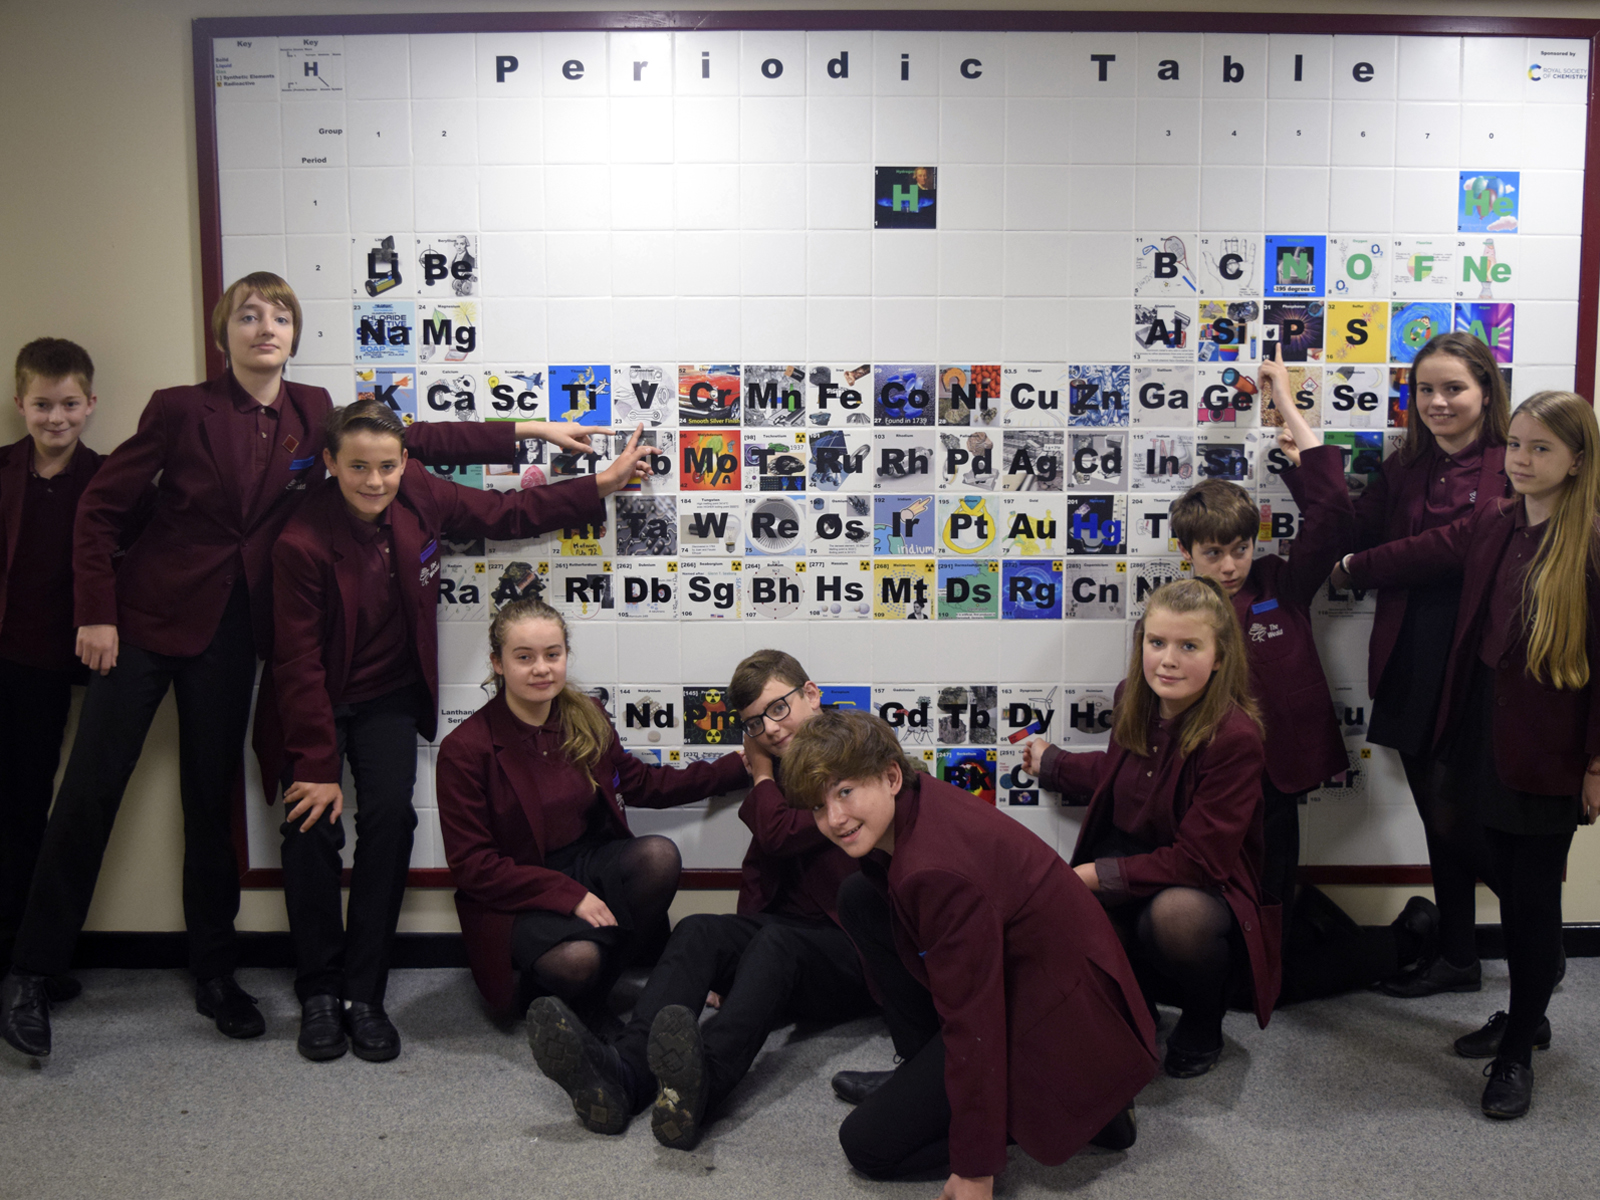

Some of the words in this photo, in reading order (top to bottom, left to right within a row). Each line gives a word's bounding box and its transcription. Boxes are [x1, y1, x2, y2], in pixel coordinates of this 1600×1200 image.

[237, 40, 253, 48] Key
[303, 39, 319, 47] Key
[304, 61, 318, 77] H
[318, 127, 343, 136] Group
[893, 184, 919, 211] H
[1464, 190, 1514, 217] He
[367, 252, 399, 279] Li
[424, 253, 473, 280] Be
[1154, 252, 1178, 279] B
[1219, 253, 1243, 280] C
[1282, 252, 1308, 279] N
[1346, 253, 1372, 280] O
[1414, 256, 1434, 282] F
[1462, 256, 1512, 283] Ne
[360, 319, 410, 345] Na
[423, 319, 476, 353] Mg
[1144, 319, 1182, 345] Al
[1212, 317, 1246, 345] Si
[1283, 319, 1305, 345] P
[1345, 318, 1368, 345] S
[374, 385, 402, 411] K
[427, 384, 476, 411] Ca
[491, 384, 539, 411] Sc
[562, 384, 597, 410] Ti
[631, 383, 659, 409] V
[689, 382, 732, 409] Cr
[748, 383, 802, 409] Mn
[818, 383, 862, 409] Fe
[881, 382, 930, 409] Co
[952, 383, 989, 410] Ni
[1010, 382, 1059, 410] Cu
[1076, 384, 1123, 410] Zn
[1139, 382, 1189, 409] Ga
[1203, 384, 1253, 412] Ge
[1332, 384, 1379, 411] Se
[684, 447, 738, 474] Mo
[817, 447, 863, 474] Ru
[881, 448, 928, 474] Rh
[947, 448, 992, 475] Pd
[1008, 449, 1057, 481] Ag
[1074, 447, 1122, 474] Cd
[1147, 449, 1179, 474] In
[1203, 449, 1248, 476] Sn
[623, 512, 668, 538] Ta
[693, 512, 729, 538] W
[752, 512, 799, 538] Re
[816, 513, 864, 540] Os
[892, 512, 920, 537] Ir
[950, 513, 988, 539] Pt
[1008, 513, 1056, 539] Au
[1072, 513, 1122, 546] Hg
[897, 544, 934, 554] iridium
[437, 578, 480, 604] Ra
[565, 577, 605, 603] Rf
[624, 577, 672, 603] Db
[688, 576, 734, 609] Sg
[753, 577, 799, 603] Bh
[817, 576, 864, 602] Hs
[882, 578, 928, 603] Mt
[946, 578, 992, 603] Ds
[1009, 576, 1055, 609] Rg
[1072, 577, 1119, 603] Cn
[626, 703, 674, 728] Nd
[879, 702, 928, 727] Gd
[944, 703, 991, 729] Tb
[1009, 703, 1055, 734] Dy
[1070, 703, 1114, 728] Ho
[944, 766, 990, 790] Bk
